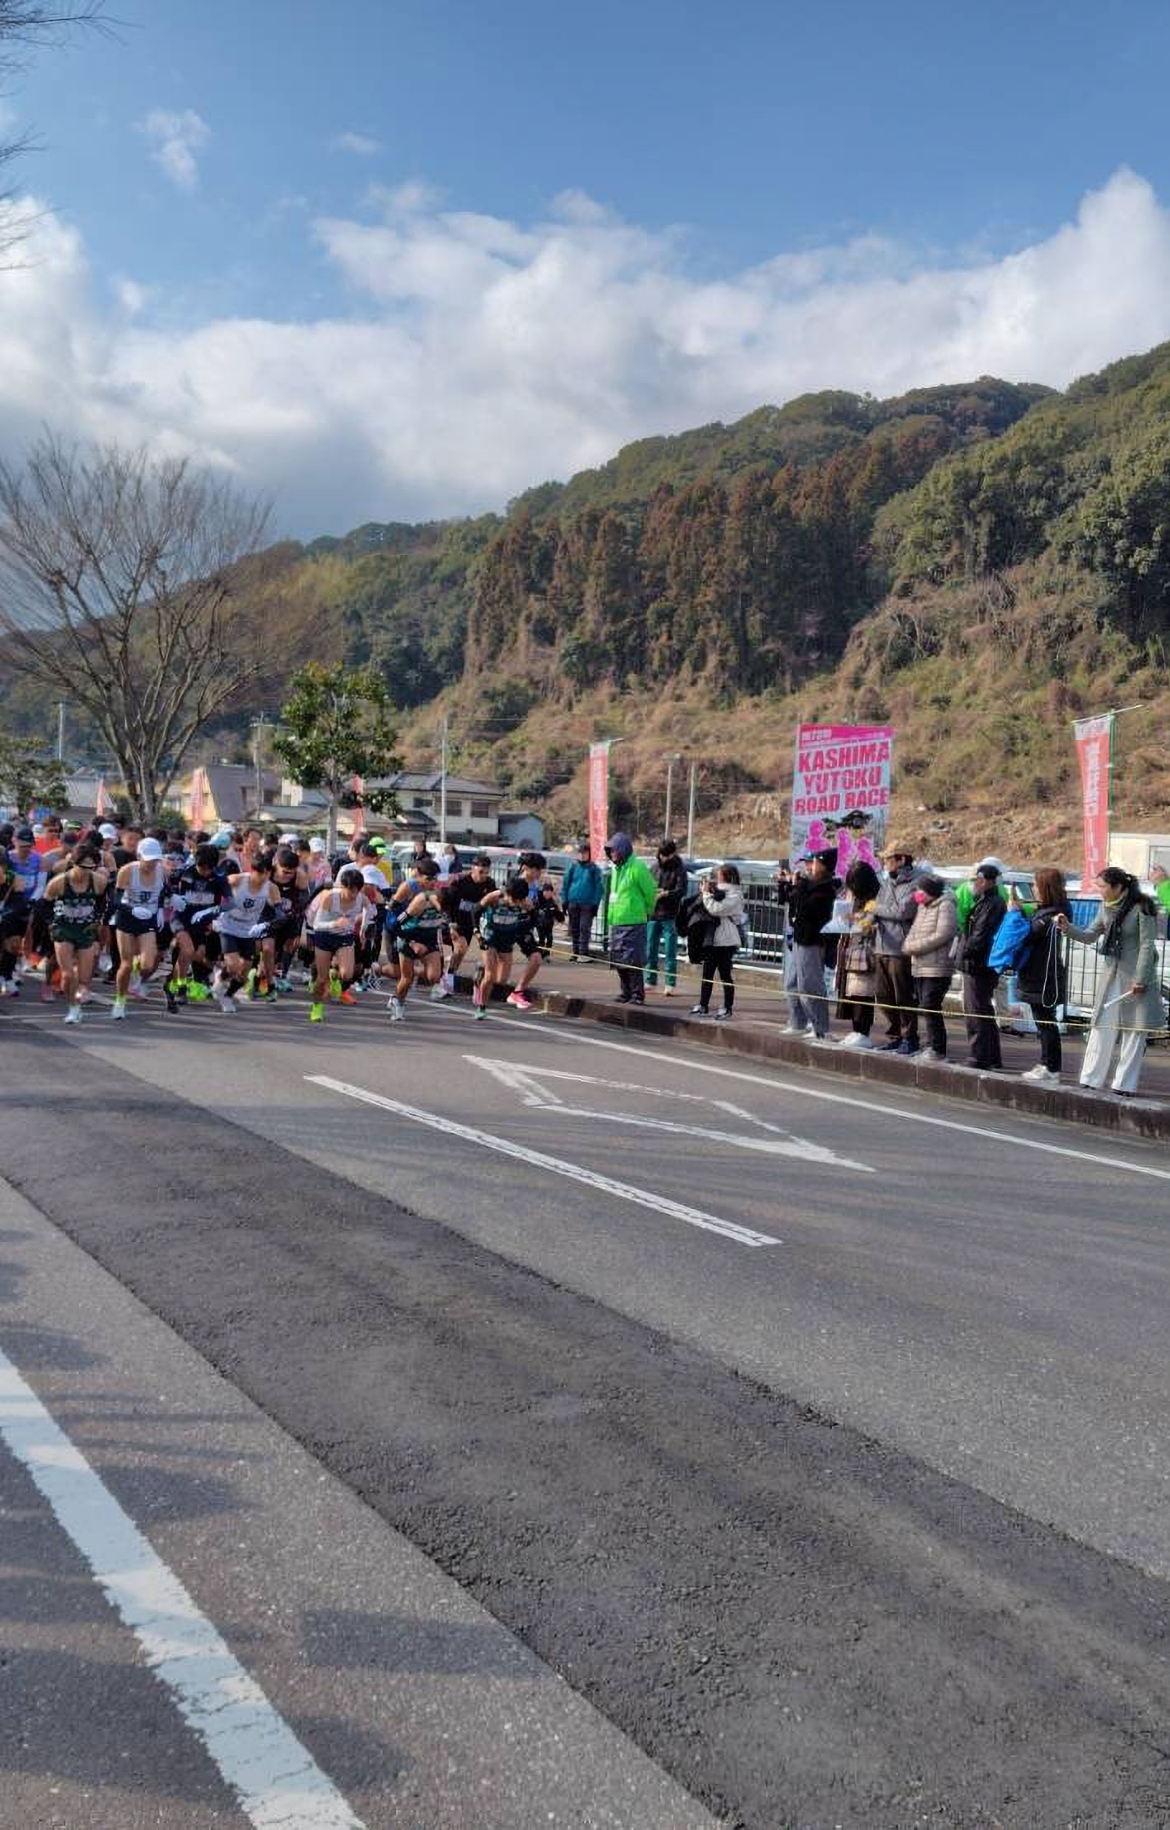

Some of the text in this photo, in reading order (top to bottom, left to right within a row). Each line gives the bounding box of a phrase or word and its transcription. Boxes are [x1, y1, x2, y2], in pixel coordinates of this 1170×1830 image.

[799, 742, 889, 773] KASHIMA
[804, 767, 882, 795] YUTOKU
[795, 788, 889, 815] ROAD RACE
